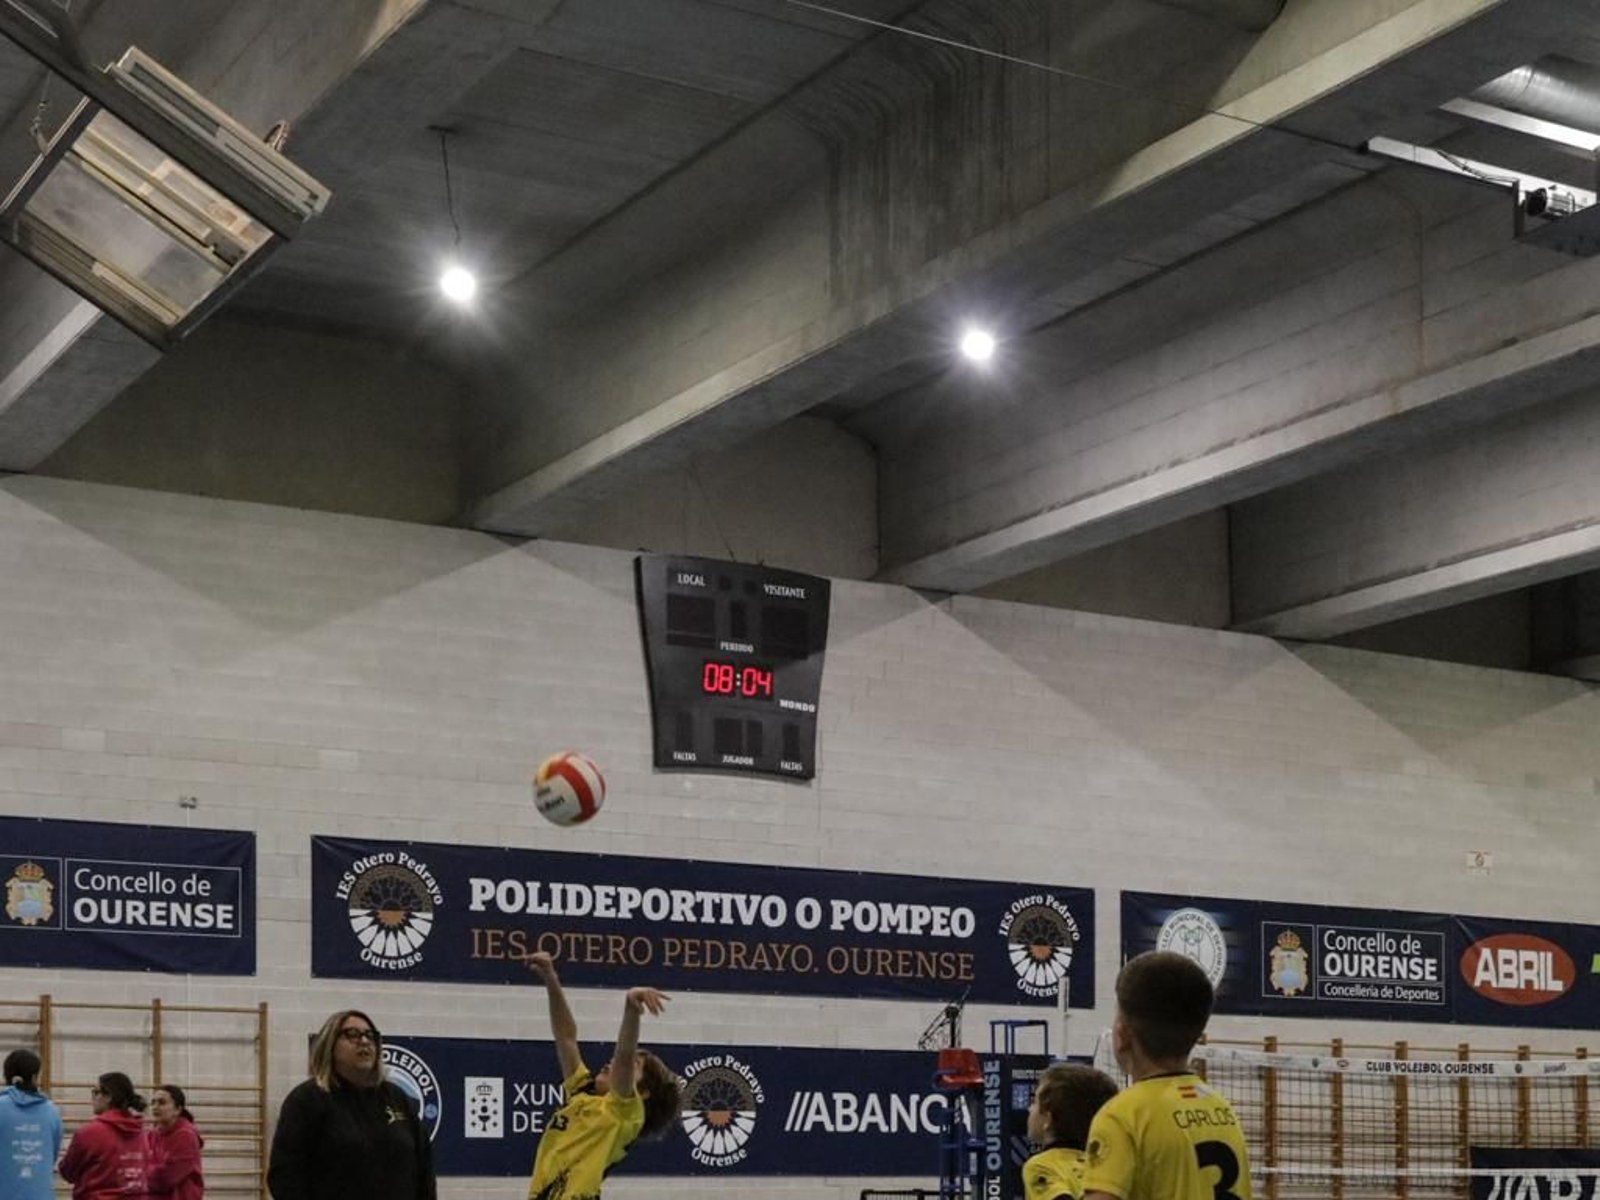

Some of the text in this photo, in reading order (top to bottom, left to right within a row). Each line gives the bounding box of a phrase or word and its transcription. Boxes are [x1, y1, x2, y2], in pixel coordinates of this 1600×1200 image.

[677, 573, 706, 587] LOCAL
[764, 584, 806, 599] VISITANTE
[720, 641, 754, 653] PERIODO
[703, 663, 772, 696] 08:04
[780, 699, 815, 712] MONDO
[673, 752, 697, 762] FALTAS
[722, 754, 754, 766] JUGADOR
[74, 868, 211, 896] Concello de
[336, 851, 443, 905] IES Otero Pedrayo
[73, 897, 234, 929] OURENSE
[468, 877, 975, 938] POLIDEPORTIVO O POMPEO
[999, 894, 1080, 941] IES Otero Pedrayo
[1324, 930, 1421, 955] Concello de
[360, 947, 423, 970] Ourense
[471, 928, 975, 981] IES OTERO PEDRAYO. OURENSE
[1324, 952, 1437, 981] OURENSE
[1474, 947, 1563, 991] ABRIL
[1017, 978, 1058, 997] Ourens
[1380, 985, 1393, 999] de
[1396, 987, 1440, 1001] Deportes
[381, 1050, 435, 1097] OLEIBOL
[684, 1055, 722, 1077] Otero
[724, 1054, 765, 1104] Pedrayo
[1366, 1061, 1495, 1074] CLUB VOLEIBOL OURENSE
[513, 1083, 564, 1106] XUN
[512, 1111, 544, 1133] DE
[983, 1060, 1001, 1171] OURENSE
[1173, 1107, 1235, 1130] CARLOS
[691, 1147, 747, 1167] Ourense
